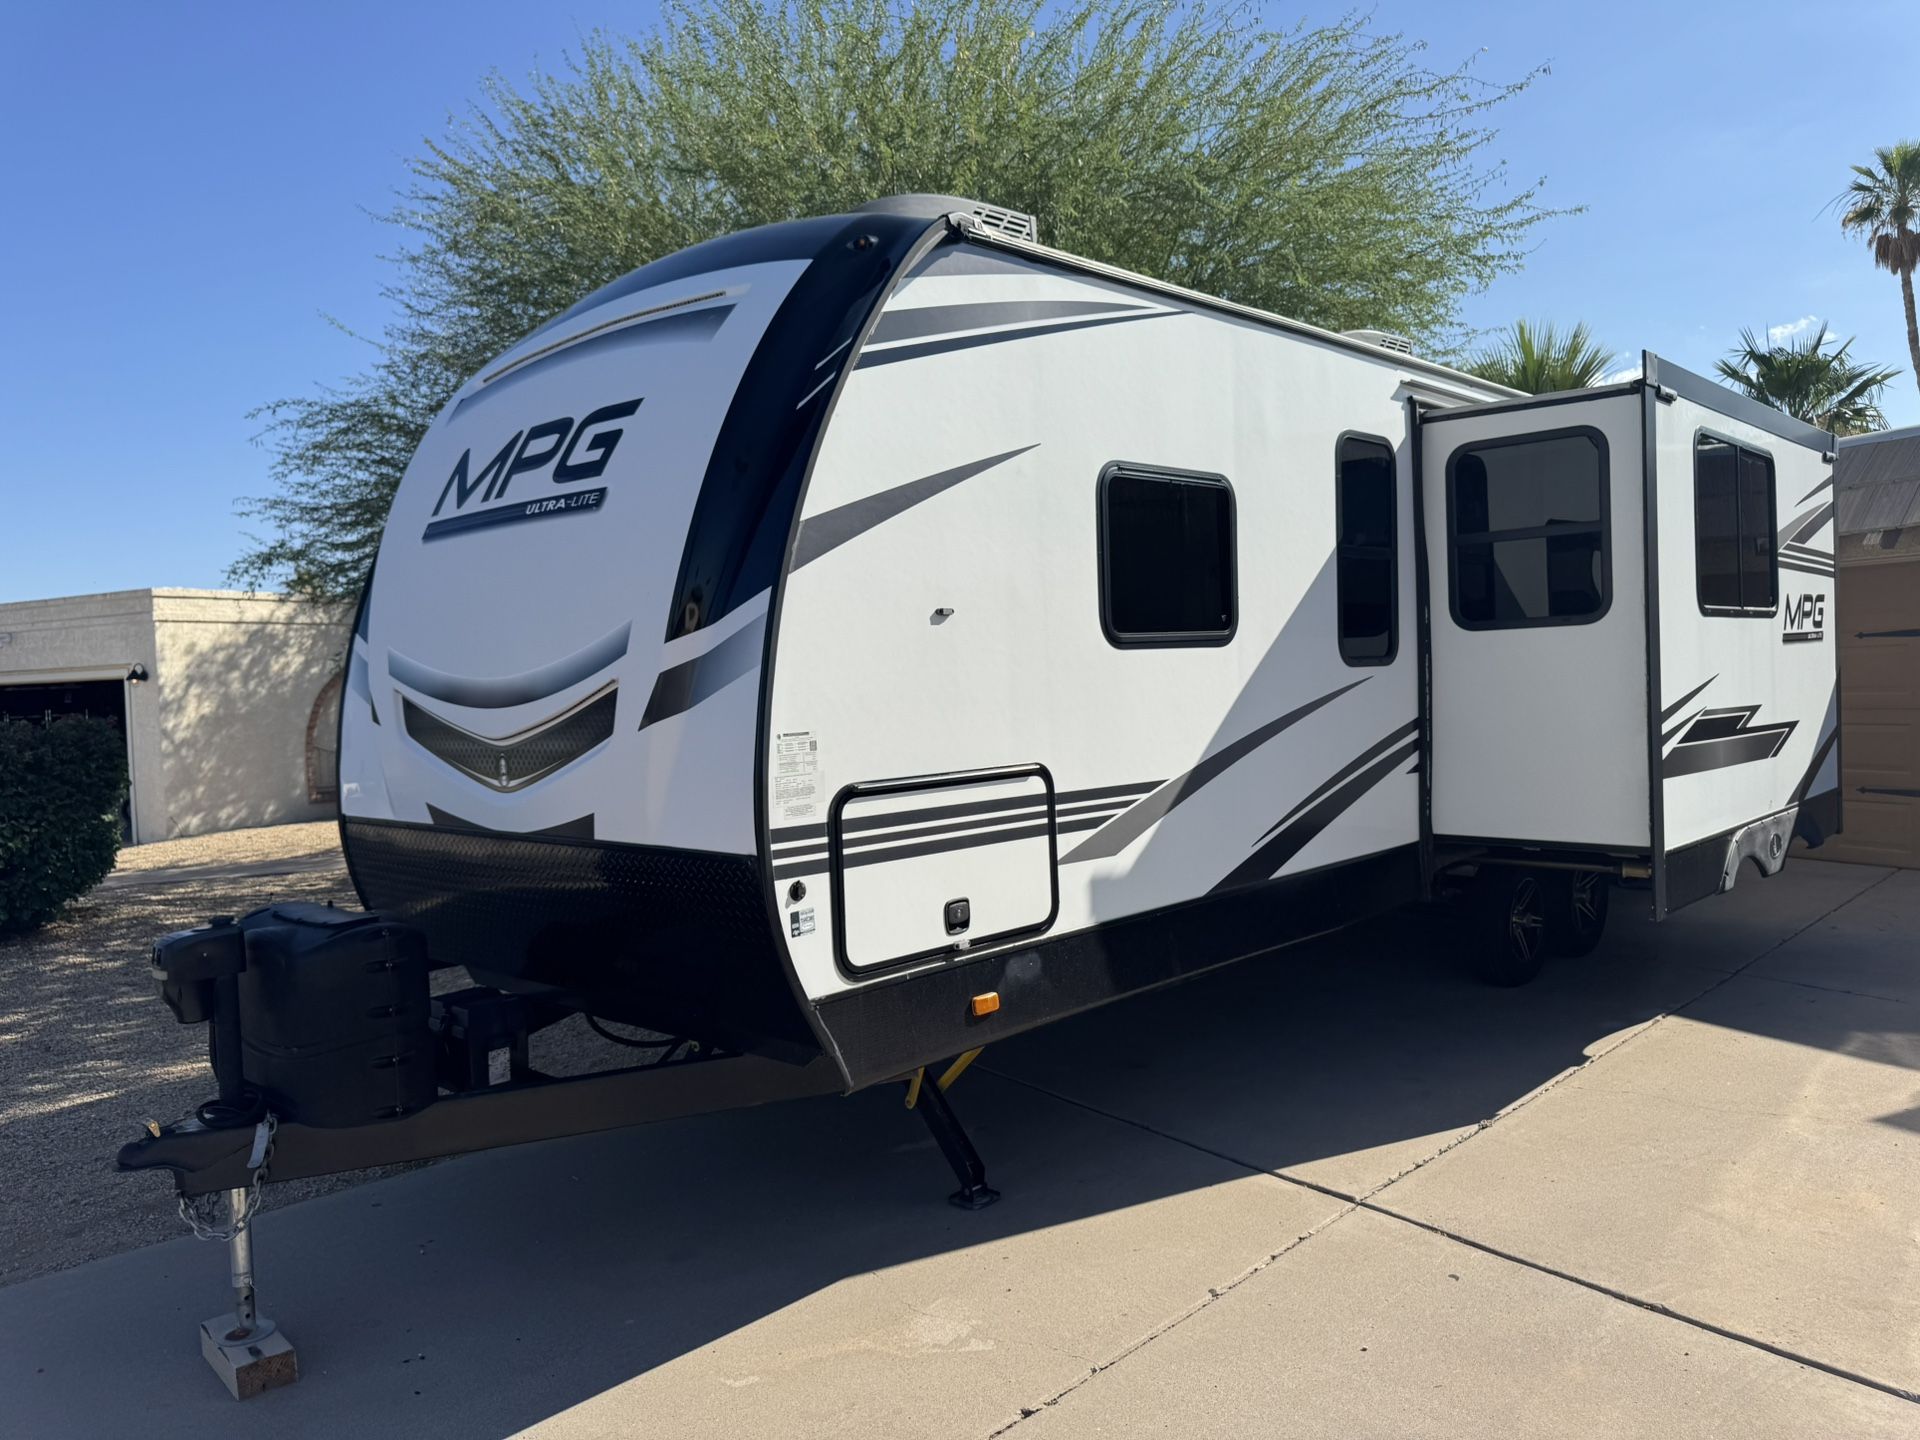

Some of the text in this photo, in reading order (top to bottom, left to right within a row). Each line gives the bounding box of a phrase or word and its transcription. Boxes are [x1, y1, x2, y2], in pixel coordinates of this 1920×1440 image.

[431, 397, 645, 517] MPG
[525, 492, 600, 515] ULTRA-LITE
[1783, 593, 1825, 631] MPG
